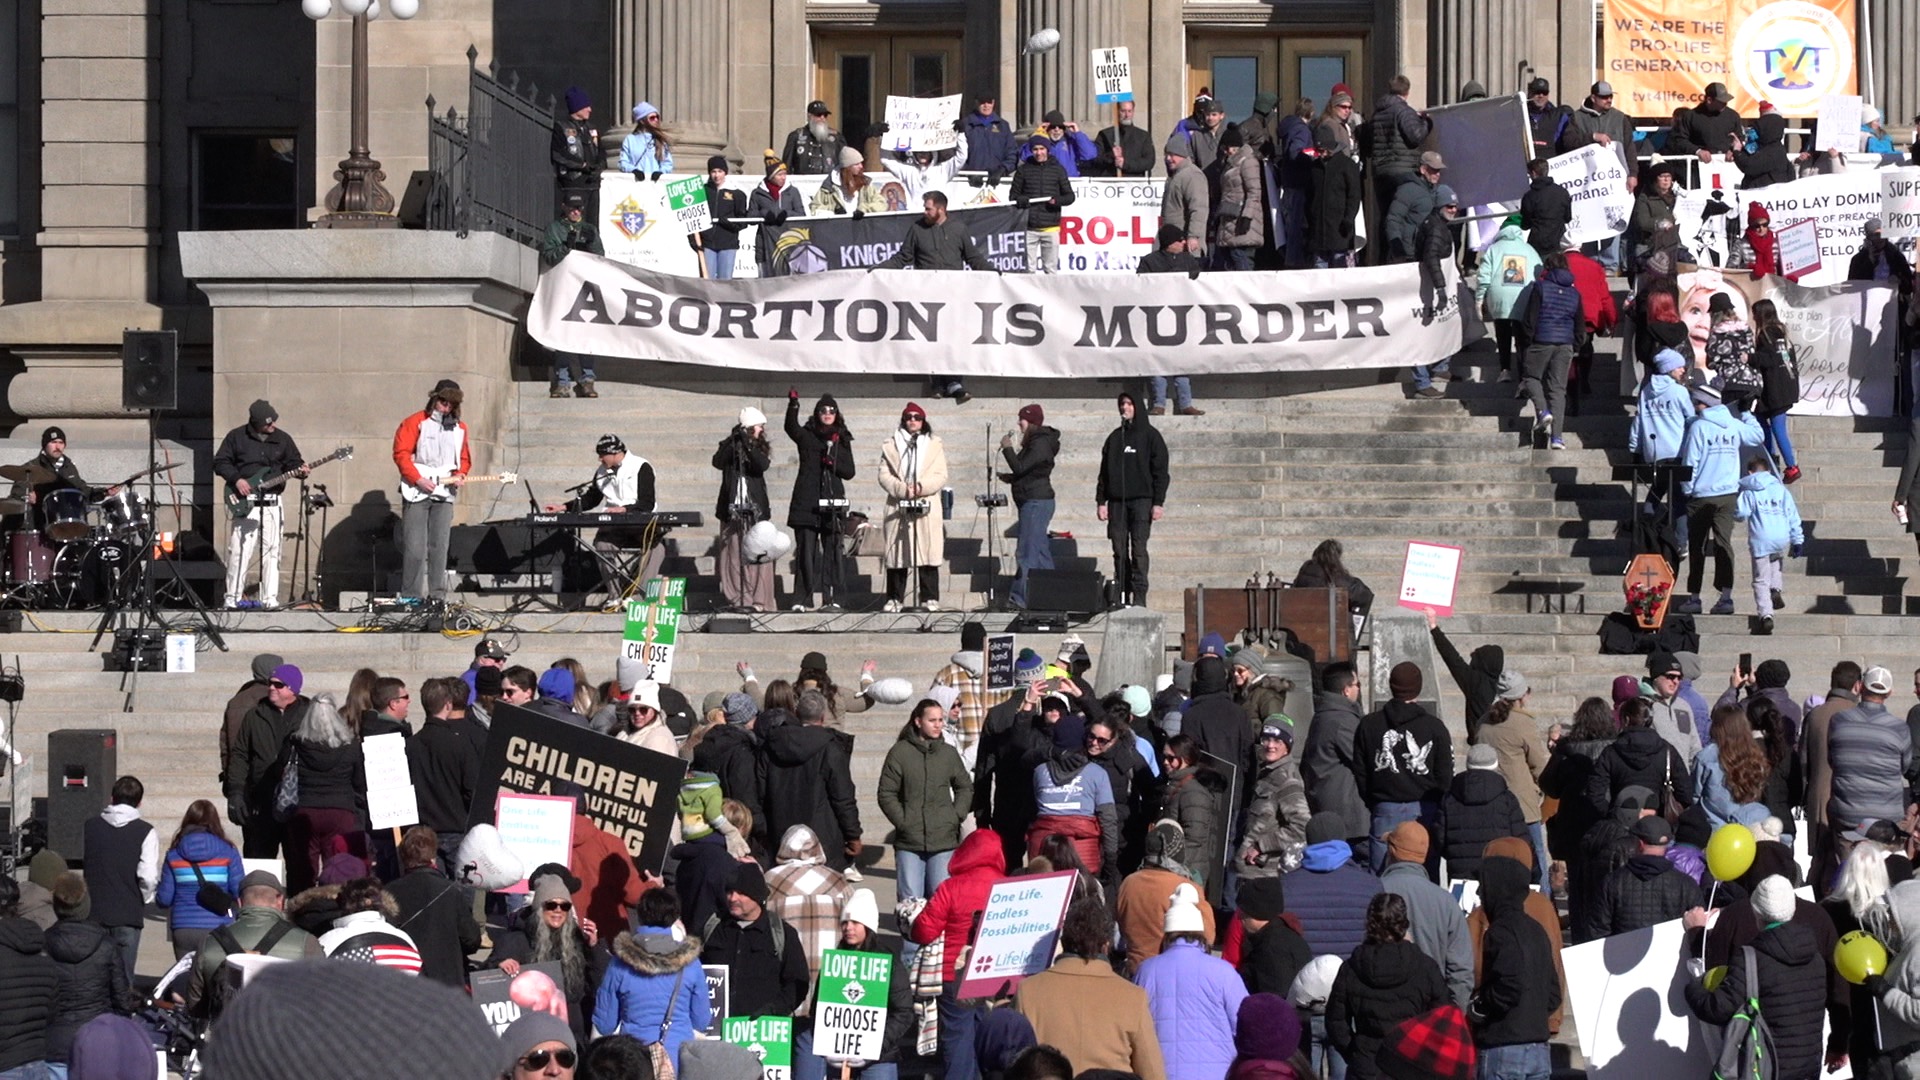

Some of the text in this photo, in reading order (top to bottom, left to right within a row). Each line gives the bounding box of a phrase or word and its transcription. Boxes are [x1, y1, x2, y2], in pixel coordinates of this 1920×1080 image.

[1615, 19, 1724, 34] WE ARE THE
[1630, 39, 1711, 54] PRO-LIFE
[1104, 49, 1116, 63] WE
[1096, 63, 1127, 79] CHOOSE
[1611, 59, 1730, 74] GENERATION.
[1105, 78, 1121, 93] LIFE
[1569, 155, 1580, 163] ES
[668, 179, 704, 198] LOVE LIFE
[1104, 186, 1125, 199] OF
[1803, 196, 1830, 209] LAY
[677, 204, 706, 222] CHOOSE
[1823, 214, 1835, 223] OF
[686, 219, 702, 232] LIFE
[840, 242, 903, 267] KNIGH
[987, 231, 1025, 255] LIFE
[1068, 252, 1087, 271] to
[561, 280, 1390, 348] ABORTION IS MURDER
[1806, 310, 1823, 321] plan
[646, 579, 683, 597] LOV LIFE
[628, 604, 676, 626] LOV LIFE
[506, 736, 659, 808] CHILDREN
[501, 767, 536, 790] ARE
[539, 780, 551, 795] A
[991, 888, 1043, 903] One Life.
[986, 908, 1029, 921] Endless
[980, 922, 1053, 938] Possibilities.
[995, 950, 1043, 967] Lifeline
[824, 953, 889, 982] LOVE LIFE
[706, 976, 723, 987] my
[480, 1001, 521, 1025] YOU
[824, 1006, 879, 1032] CHOOSE
[726, 1020, 789, 1043] LOVE LIFE
[834, 1032, 863, 1056] LIFE
